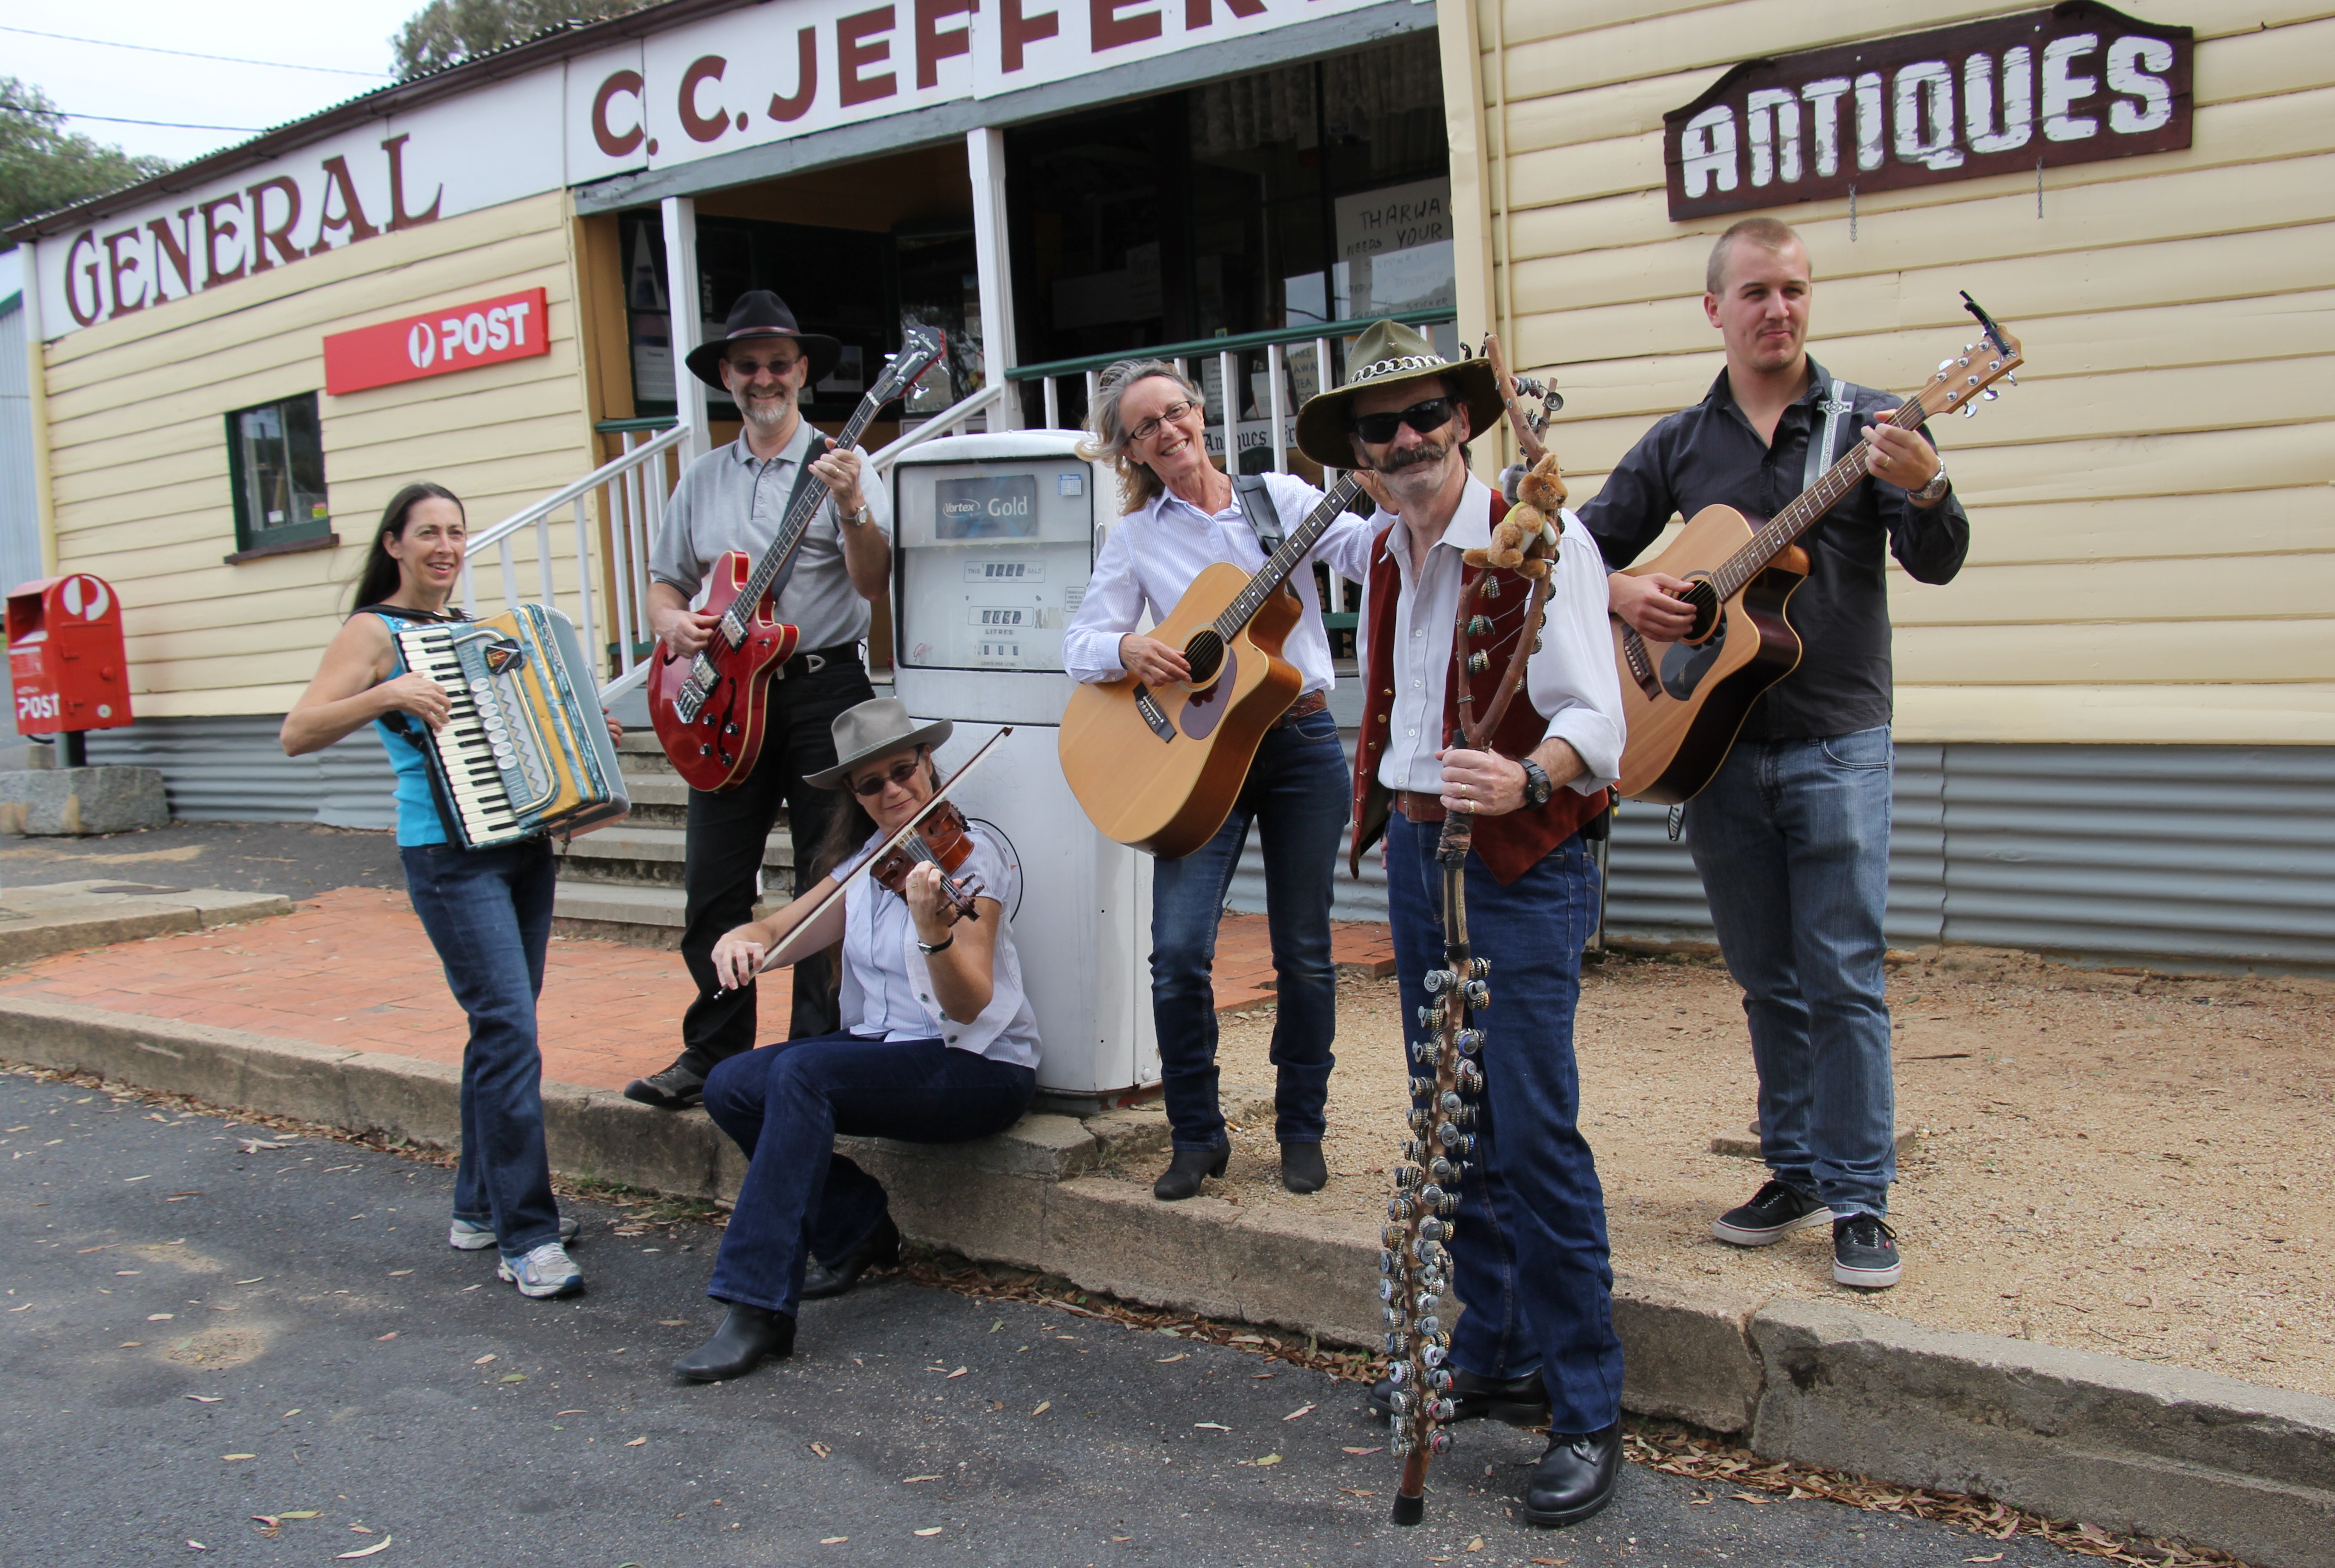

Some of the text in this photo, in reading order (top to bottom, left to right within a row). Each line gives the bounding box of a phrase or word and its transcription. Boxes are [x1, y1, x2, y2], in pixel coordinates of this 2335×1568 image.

[591, 69, 658, 157] C.
[678, 53, 748, 142] C.
[1681, 33, 2175, 200] ANTIQUES
[1359, 198, 1441, 230] THARWA
[64, 132, 444, 327] GENERAL
[1347, 222, 1443, 256] NEEDS YOUR
[1406, 297, 1448, 312] STICKER
[442, 301, 530, 360] POST
[1293, 361, 1318, 374] AWA
[1296, 378, 1313, 388] TEA
[1203, 430, 1267, 452] Anques
[945, 496, 1028, 517] Vortex Gold
[17, 692, 61, 721] POST
